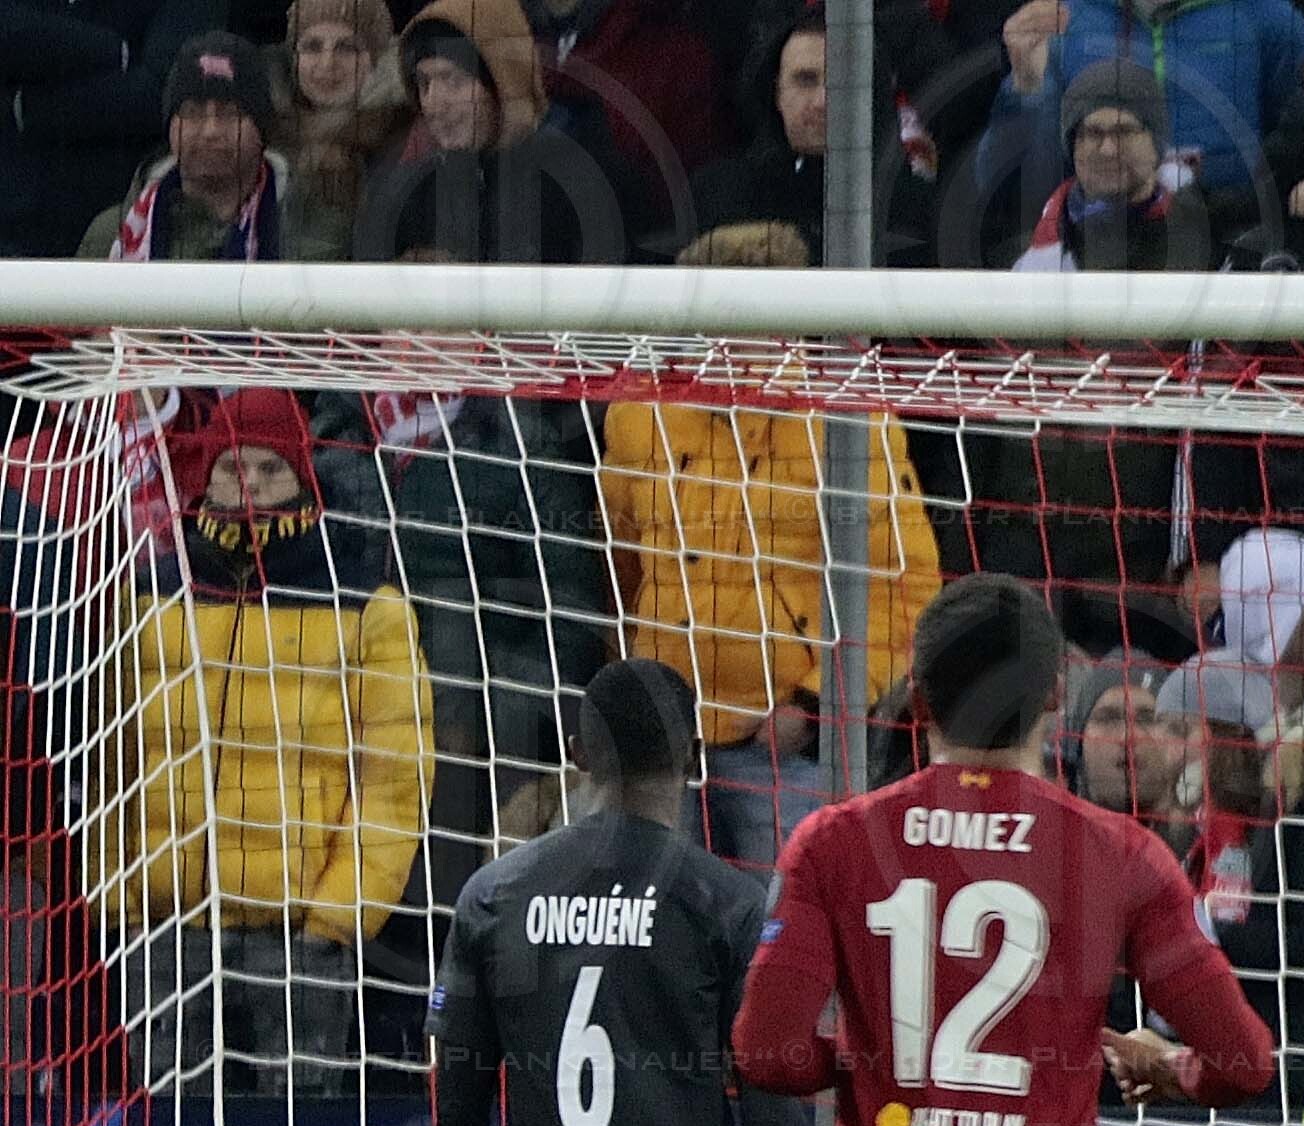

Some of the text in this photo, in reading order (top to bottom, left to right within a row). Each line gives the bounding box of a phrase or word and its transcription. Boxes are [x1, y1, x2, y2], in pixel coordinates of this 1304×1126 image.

[904, 807, 1036, 853] GOMEZ
[526, 884, 656, 946] ONGUÉNÉ
[867, 878, 1048, 1096] 12
